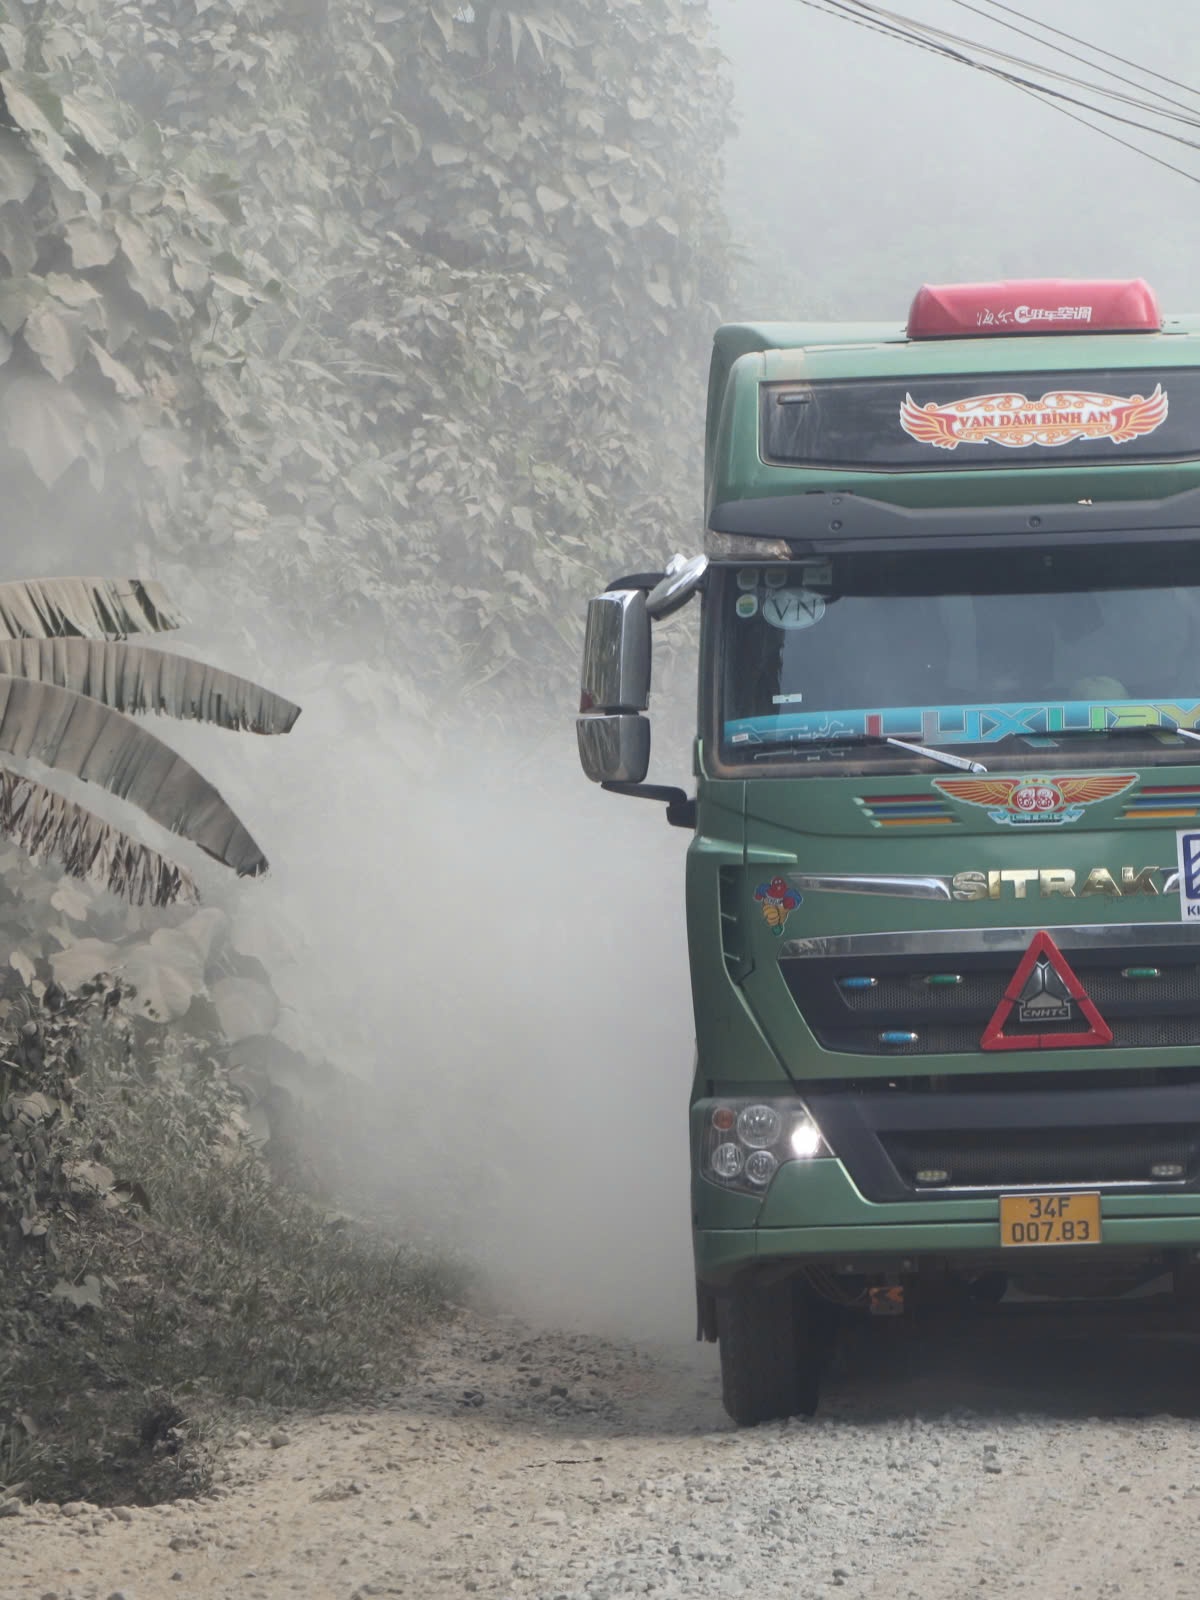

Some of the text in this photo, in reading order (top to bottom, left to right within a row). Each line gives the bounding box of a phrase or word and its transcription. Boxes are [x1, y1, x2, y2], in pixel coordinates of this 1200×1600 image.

[1087, 411, 1112, 423] AN
[770, 598, 818, 621] VN
[951, 865, 1165, 902] SITRAK
[1023, 1006, 1068, 1018] CNHTC
[1028, 1197, 1071, 1219] 34F
[1011, 1220, 1090, 1244] 007.83
